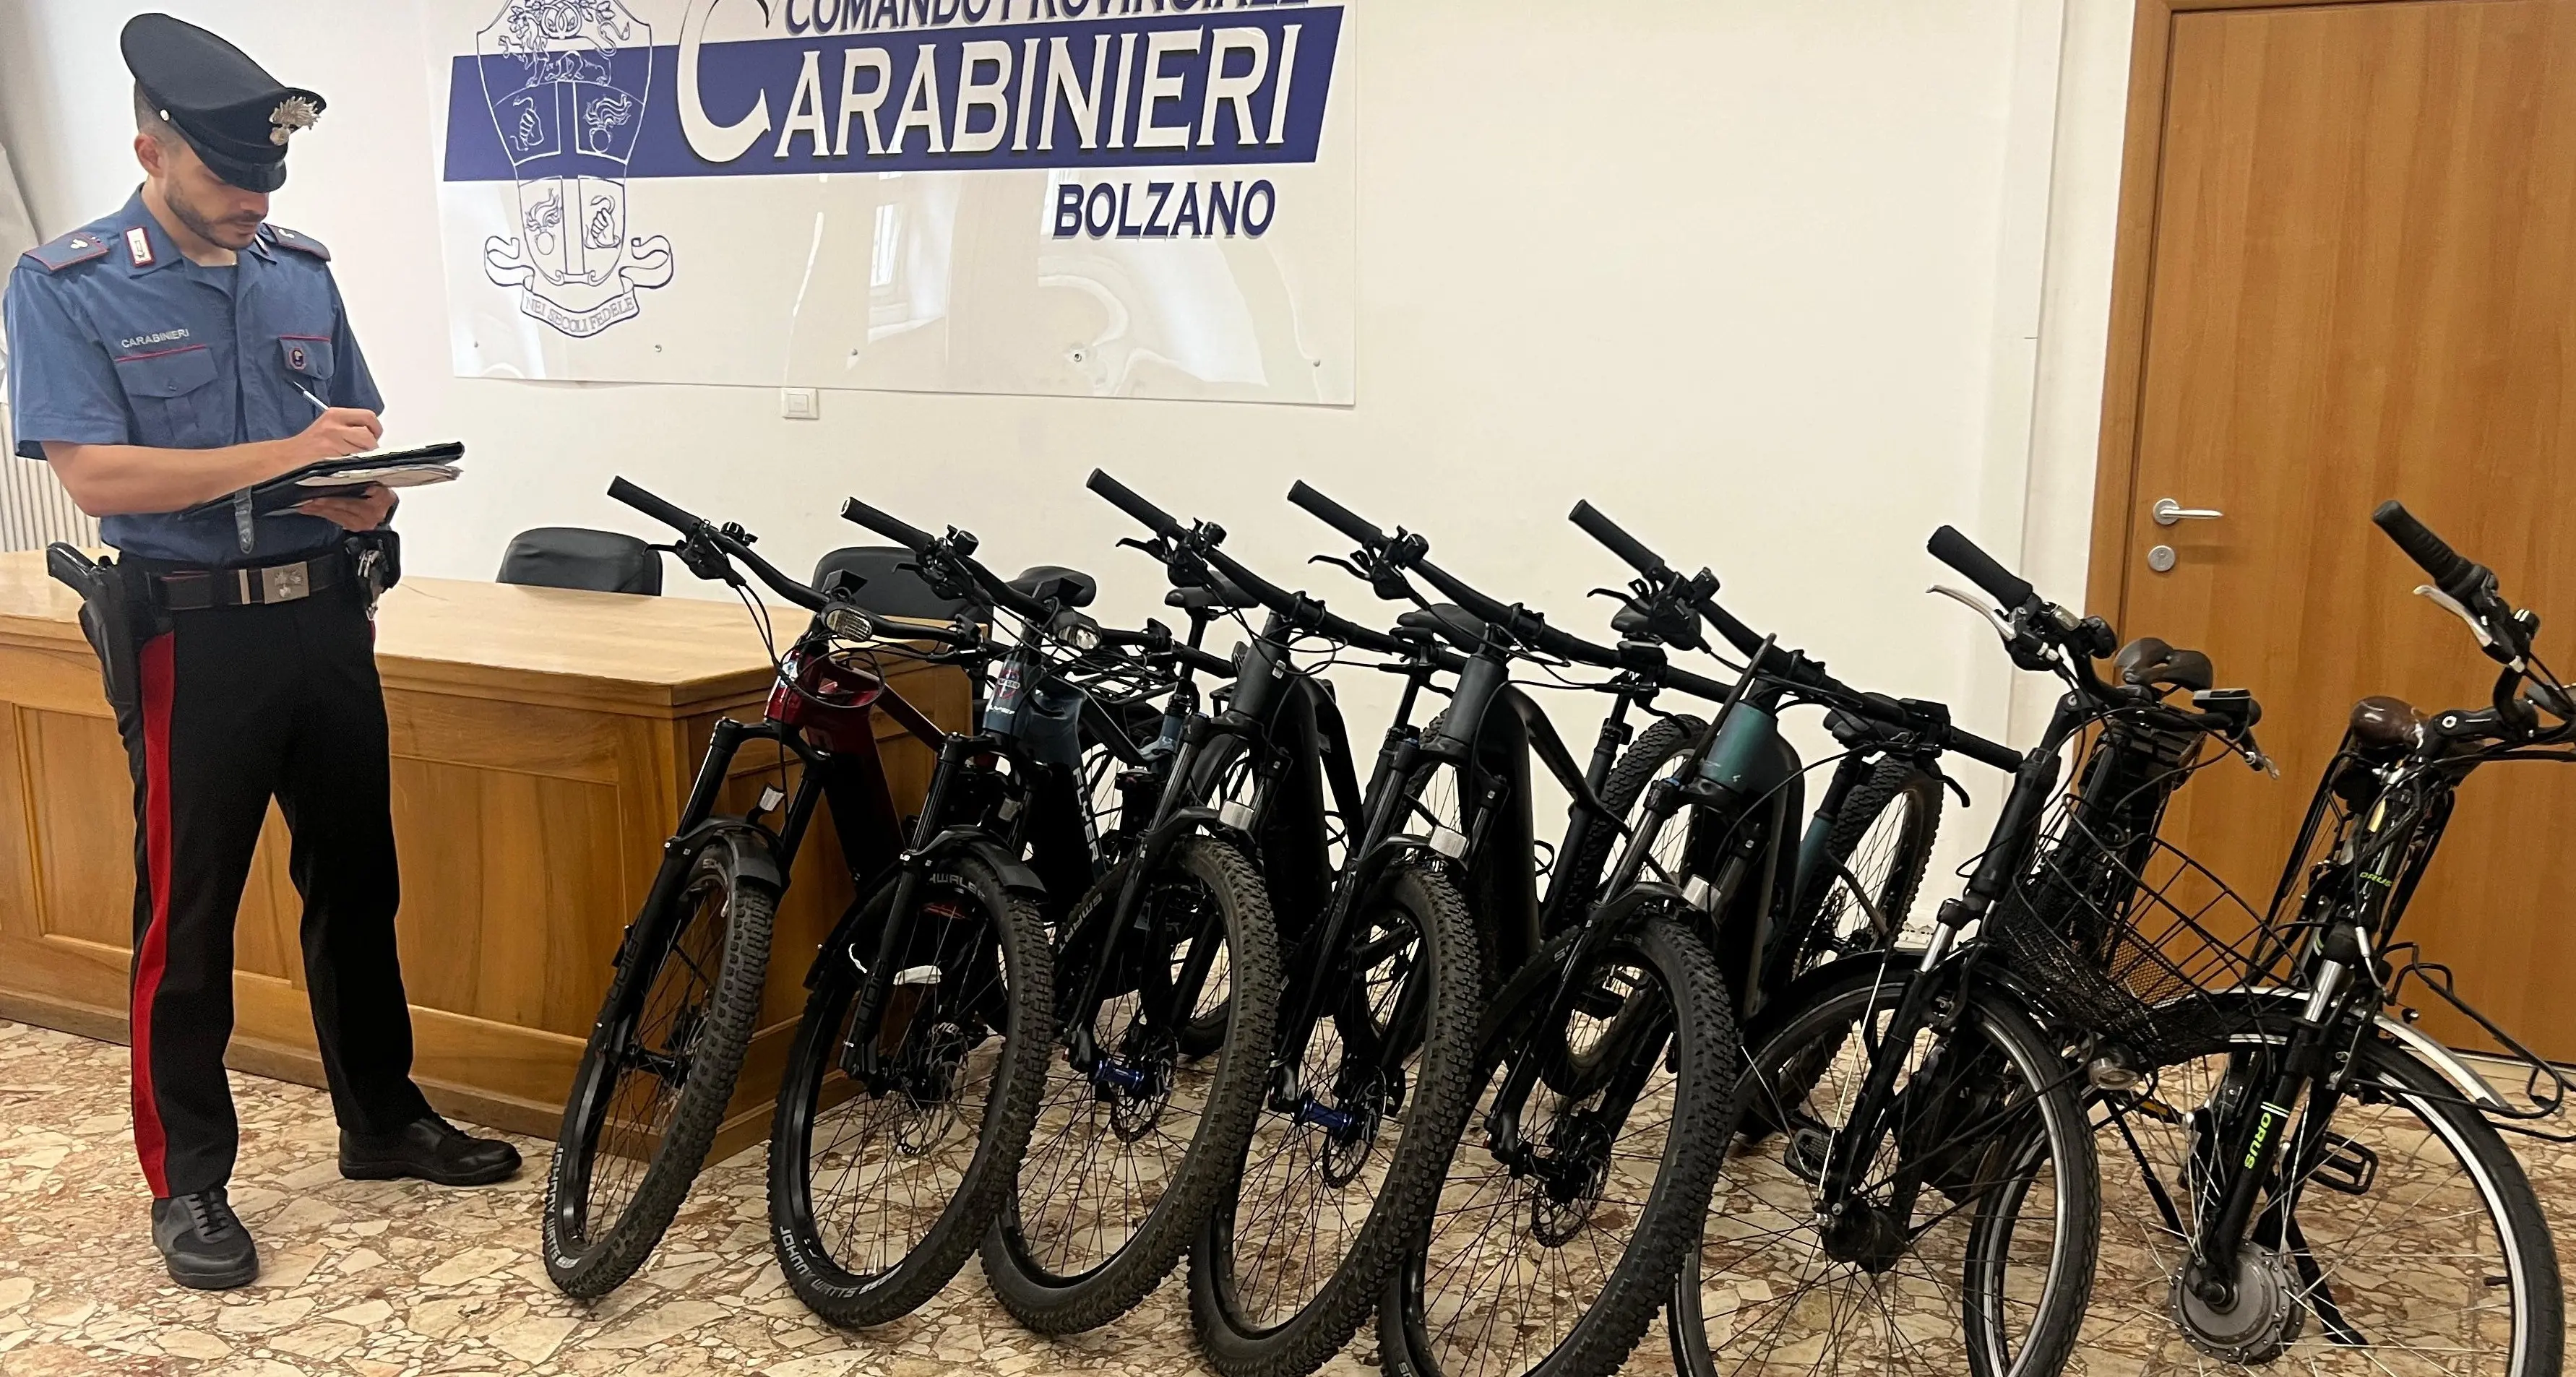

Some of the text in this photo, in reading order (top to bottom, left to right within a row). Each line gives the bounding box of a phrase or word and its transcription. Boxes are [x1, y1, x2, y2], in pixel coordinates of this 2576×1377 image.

[677, 0, 1303, 163] CARABINIERI
[1053, 178, 1277, 240] BOLZANO
[121, 328, 190, 348] CARABINIERI
[525, 296, 635, 333] NEI SECOLI FEDELE
[1072, 766, 1100, 865] FLYER
[2244, 1112, 2272, 1169] ORUS
[780, 1226, 817, 1279] JOHNNY
